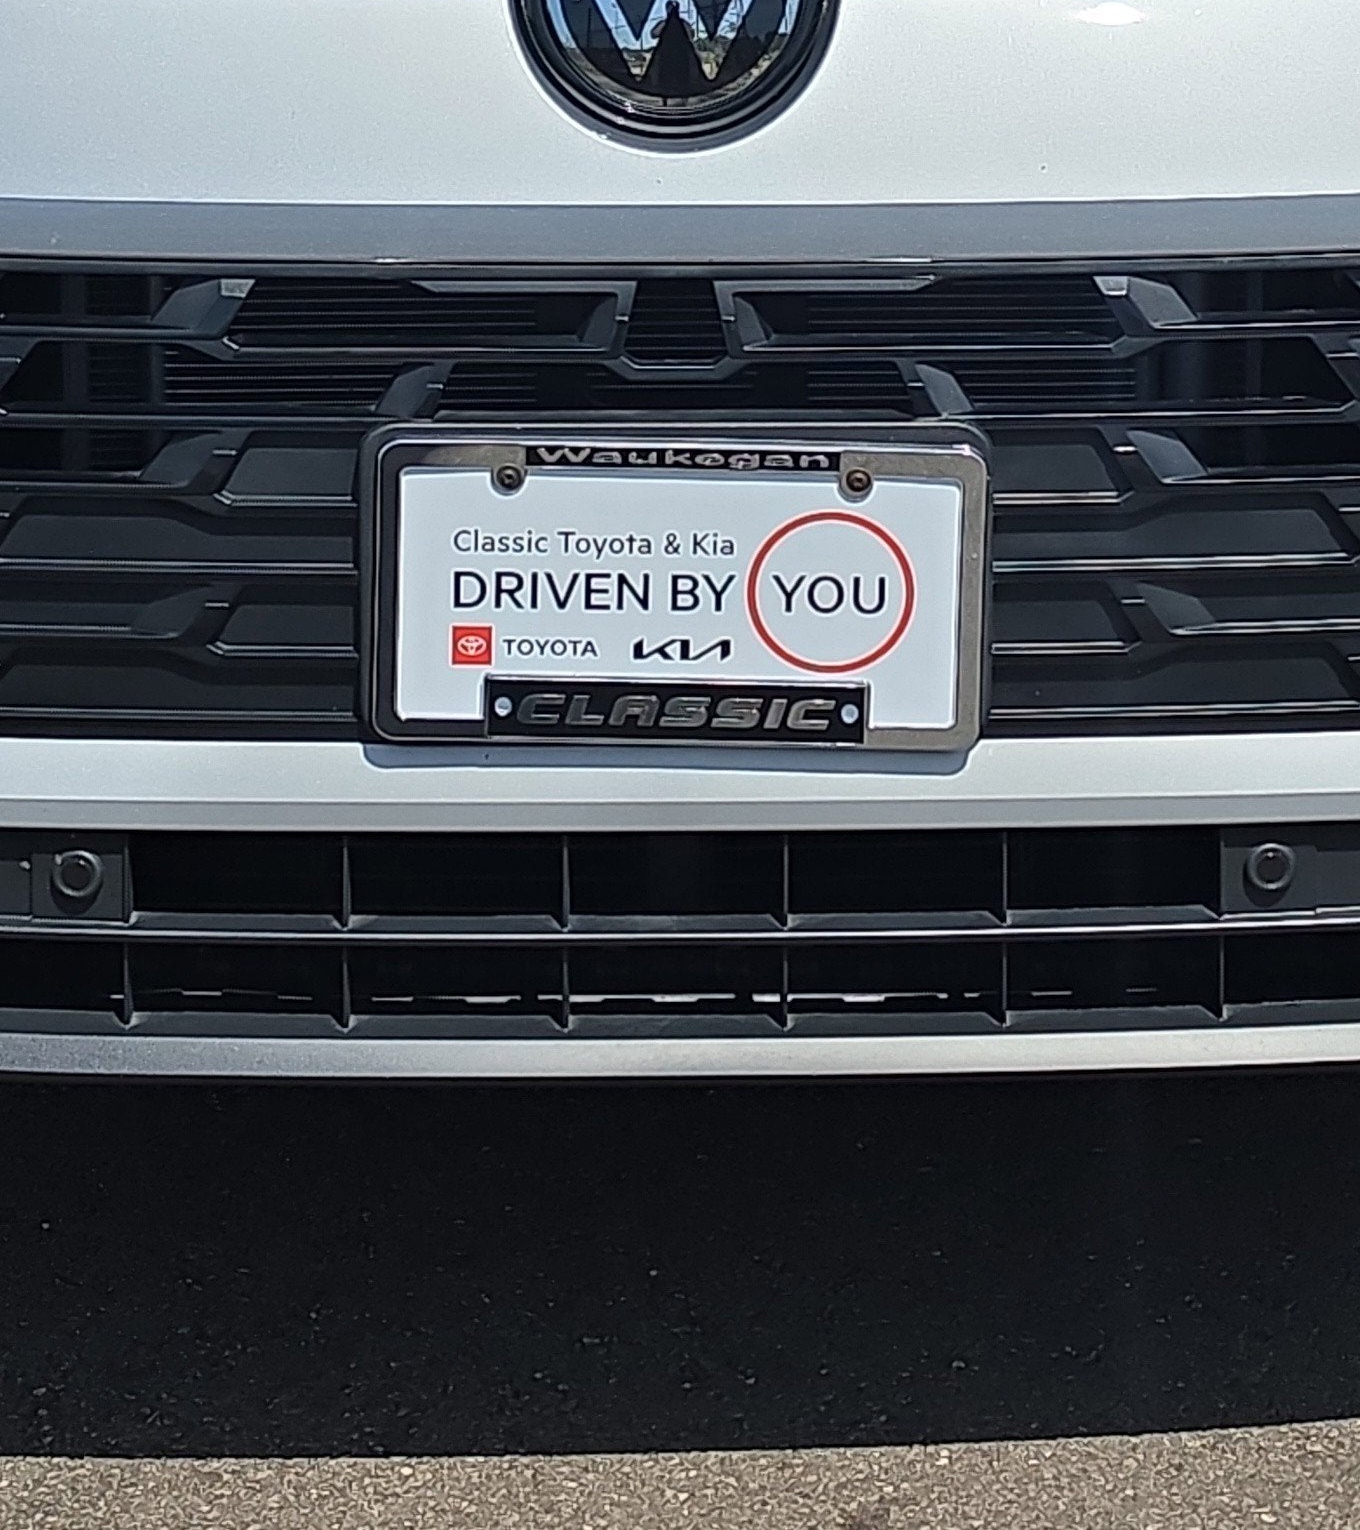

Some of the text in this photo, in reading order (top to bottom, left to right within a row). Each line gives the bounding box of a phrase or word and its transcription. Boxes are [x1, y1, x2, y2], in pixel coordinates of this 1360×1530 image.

[536, 446, 830, 470] Waukegan
[453, 530, 736, 558] Classic Toyota & Kia
[453, 572, 886, 613] DRIVEN BY YOU
[503, 638, 598, 658] TOYOTA
[517, 694, 837, 730] CLASSIC
